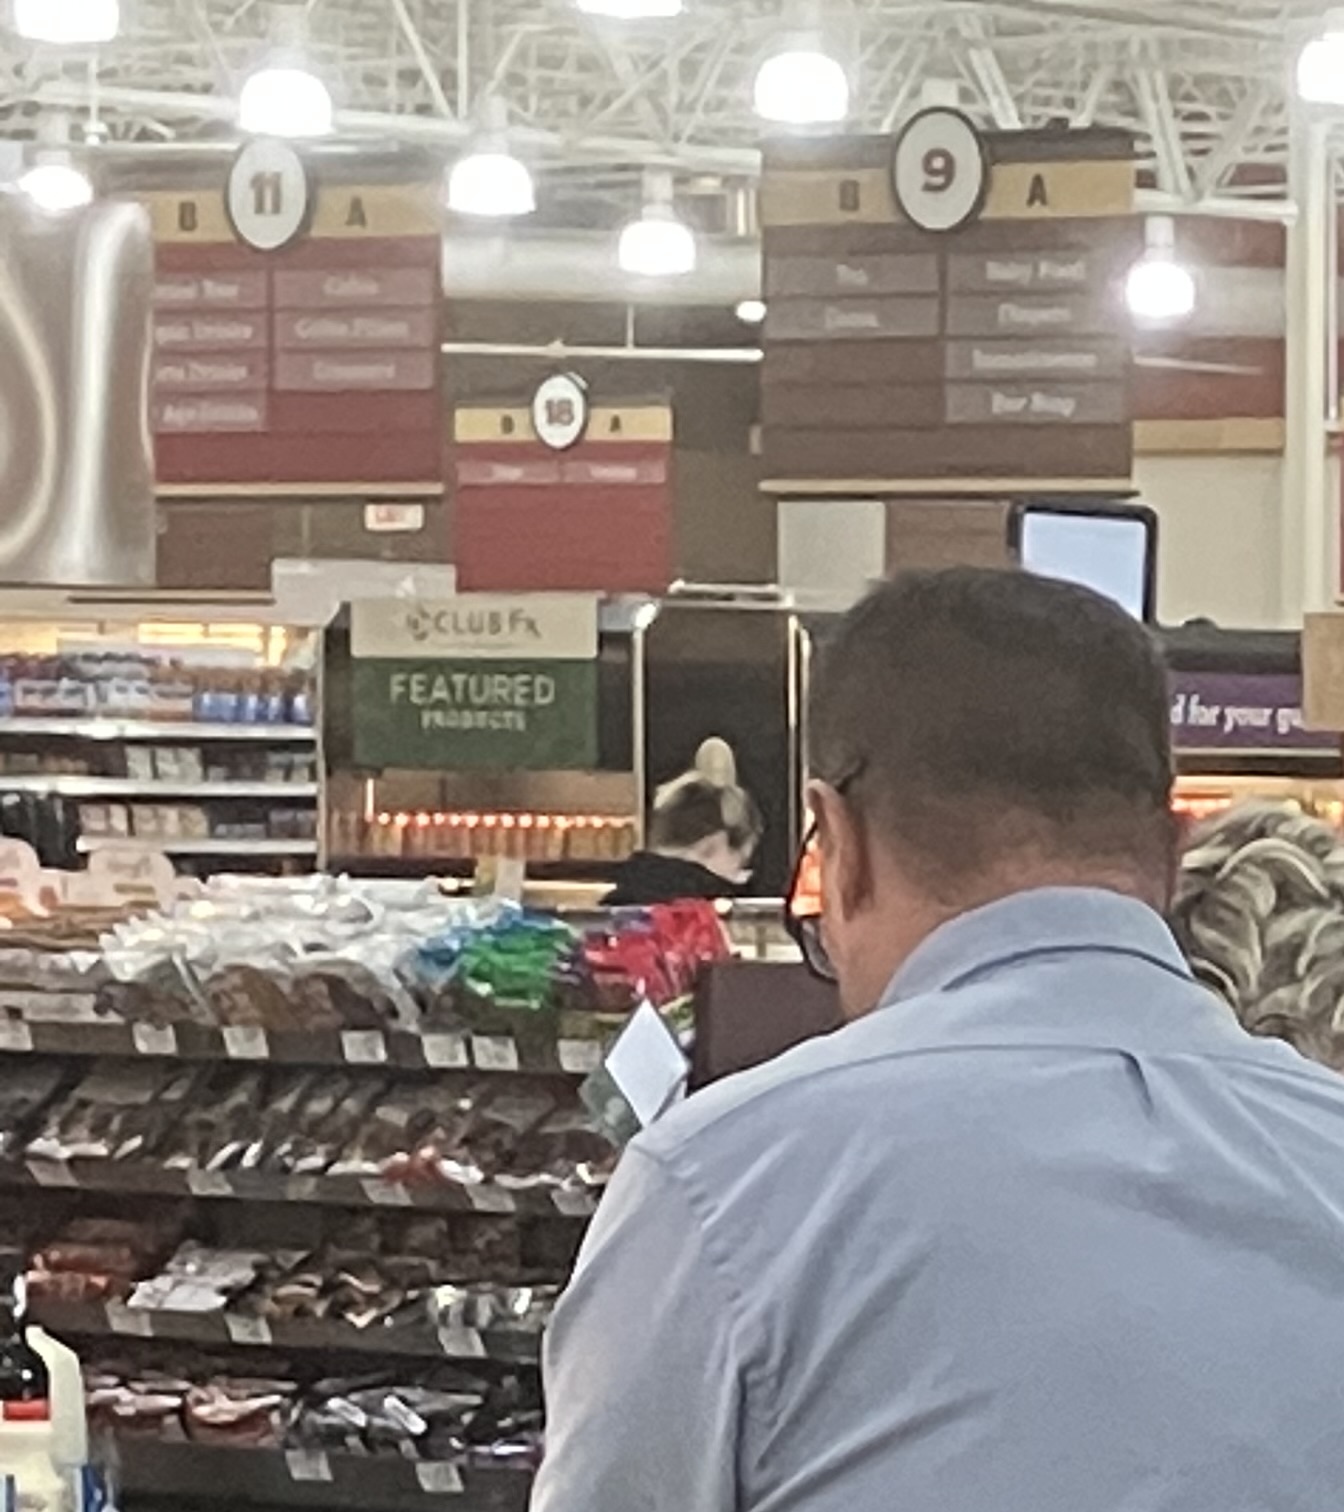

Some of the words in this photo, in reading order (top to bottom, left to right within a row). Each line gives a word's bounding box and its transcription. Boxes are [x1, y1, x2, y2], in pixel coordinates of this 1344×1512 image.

[921, 148, 956, 192] 9
[1026, 173, 1048, 207] A
[251, 171, 283, 215] 11
[345, 196, 367, 227] A
[389, 673, 556, 706] FEATURED
[420, 710, 527, 732] PRODUCTS
[1188, 694, 1221, 726] for
[1223, 706, 1273, 733] your
